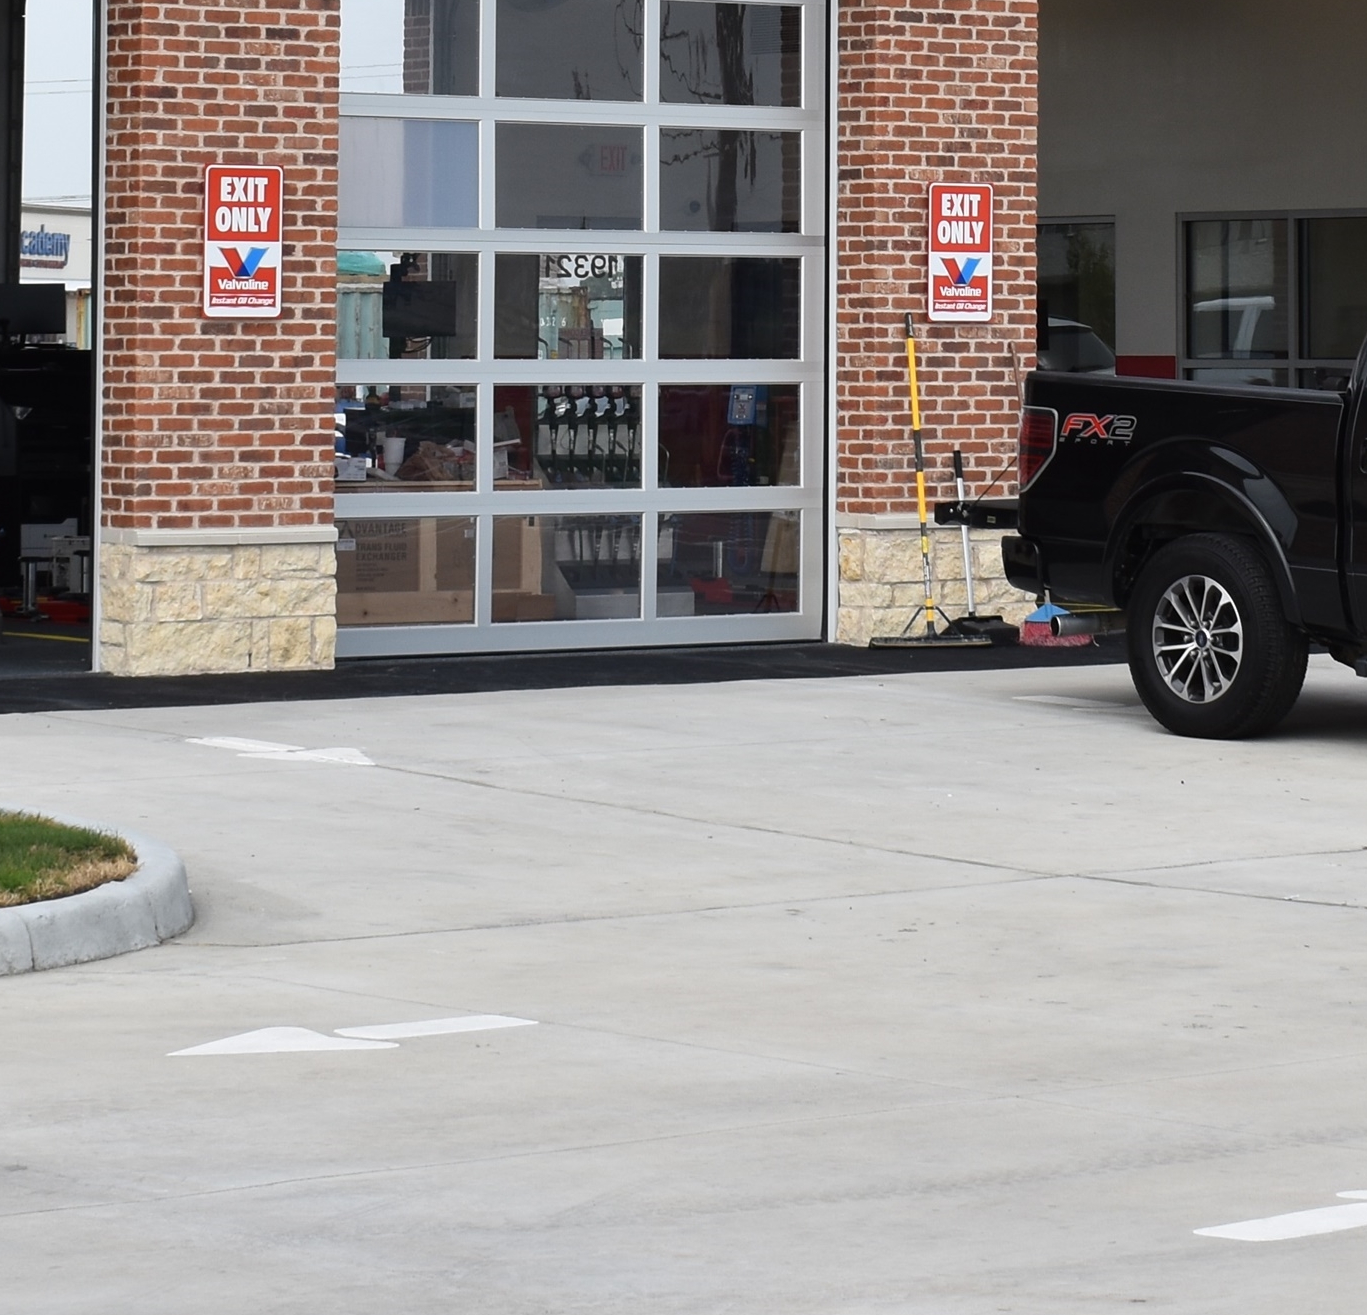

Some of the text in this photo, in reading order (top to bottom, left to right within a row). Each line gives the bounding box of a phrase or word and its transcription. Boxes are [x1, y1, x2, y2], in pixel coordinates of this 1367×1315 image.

[601, 145, 628, 171] EXIT
[220, 176, 268, 203] EXIT
[941, 193, 981, 217] EXIT
[215, 206, 272, 232] ONLY
[937, 220, 984, 244] ONLY
[20, 224, 70, 266] cademy
[218, 278, 269, 290] Valvoline
[939, 286, 982, 297] Valvoline
[211, 296, 274, 306] Instant Oil Change
[934, 302, 987, 311] Instant Oil Change
[1061, 413, 1137, 440] FX2
